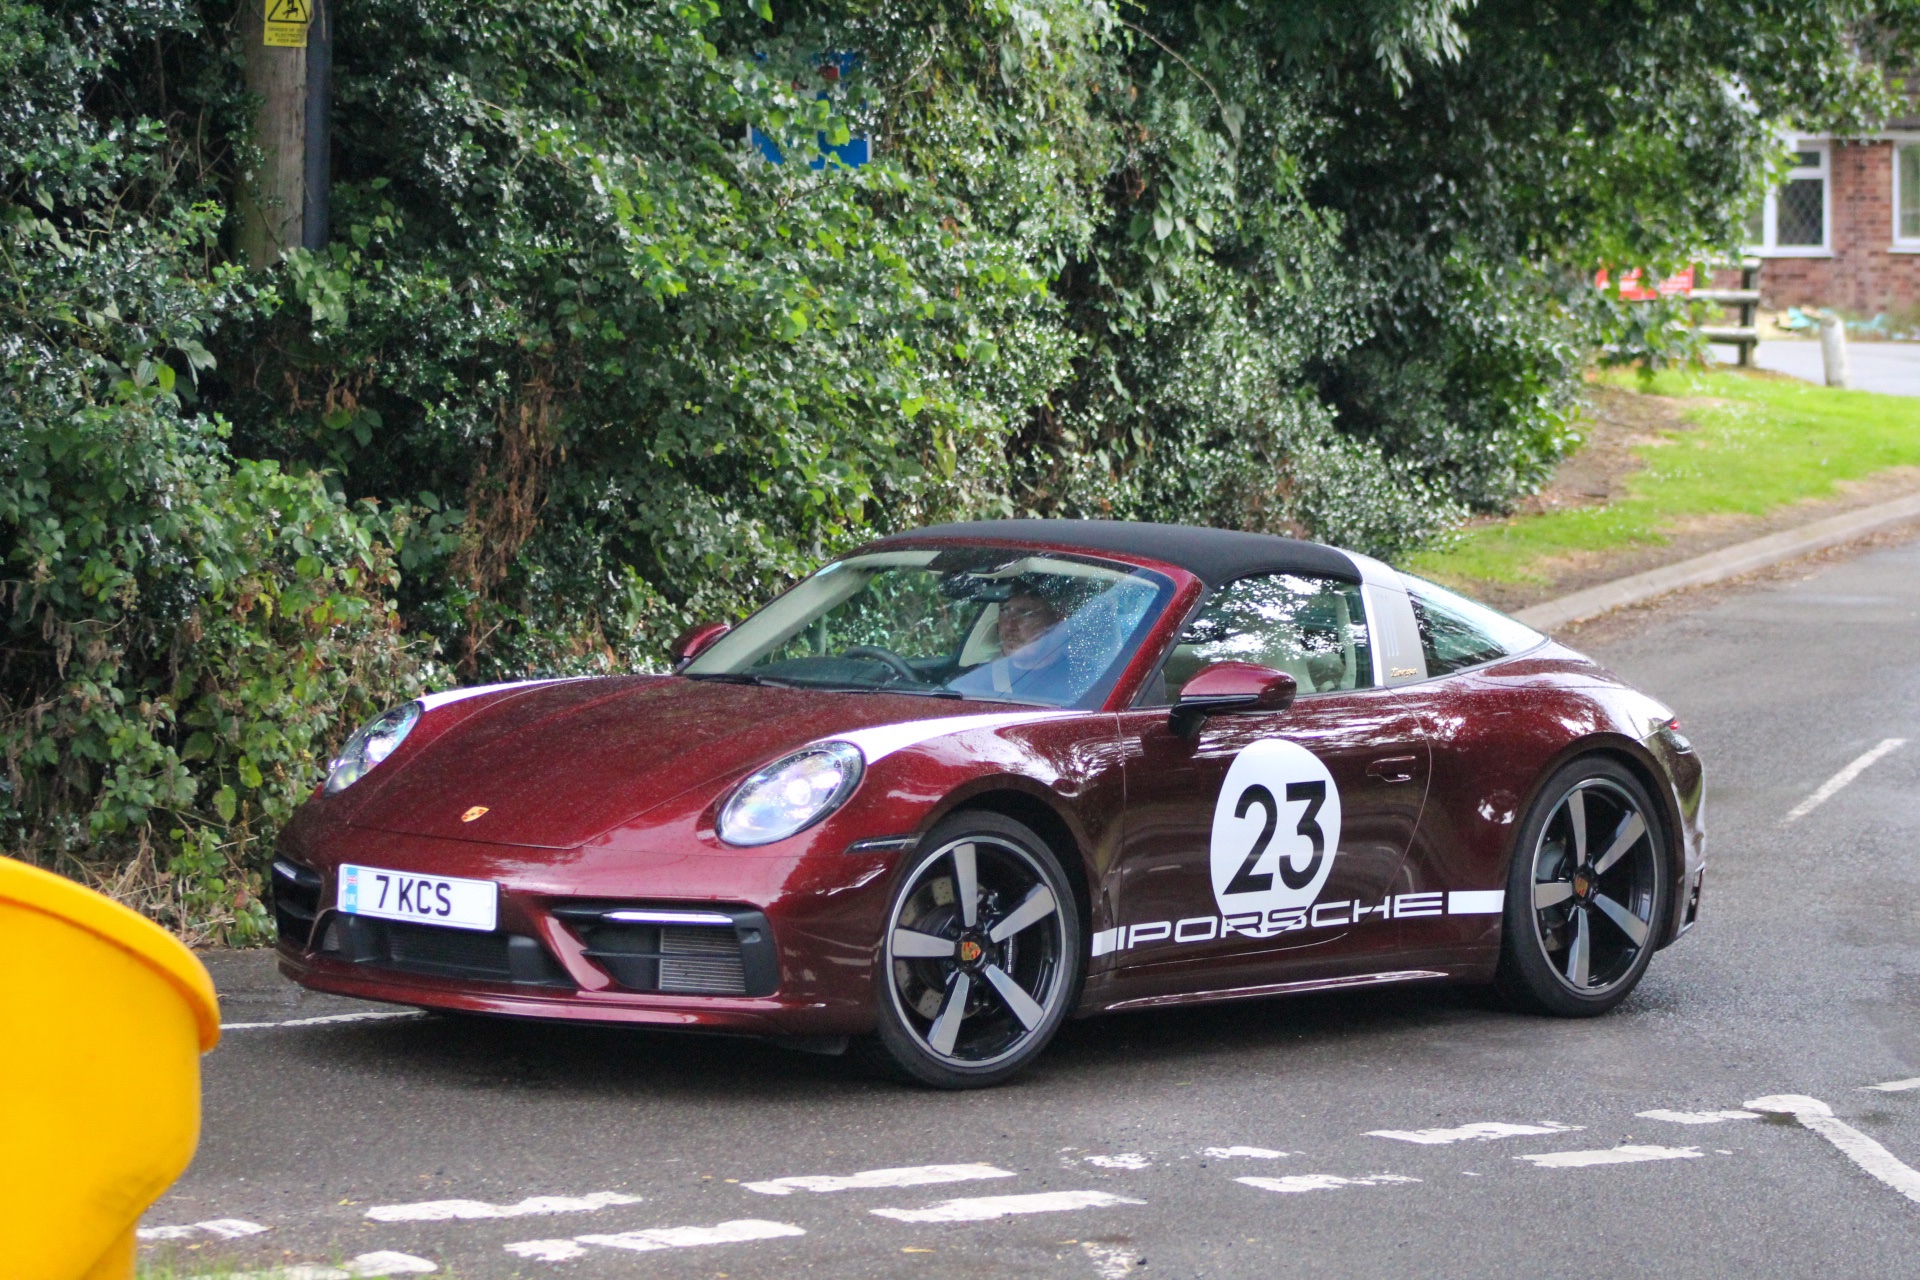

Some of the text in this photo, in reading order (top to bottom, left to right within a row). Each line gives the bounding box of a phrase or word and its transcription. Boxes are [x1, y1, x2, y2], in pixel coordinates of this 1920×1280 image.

[1222, 779, 1327, 896] 23
[376, 874, 451, 917] 7 KCS
[1127, 891, 1444, 950] PORSCHE
